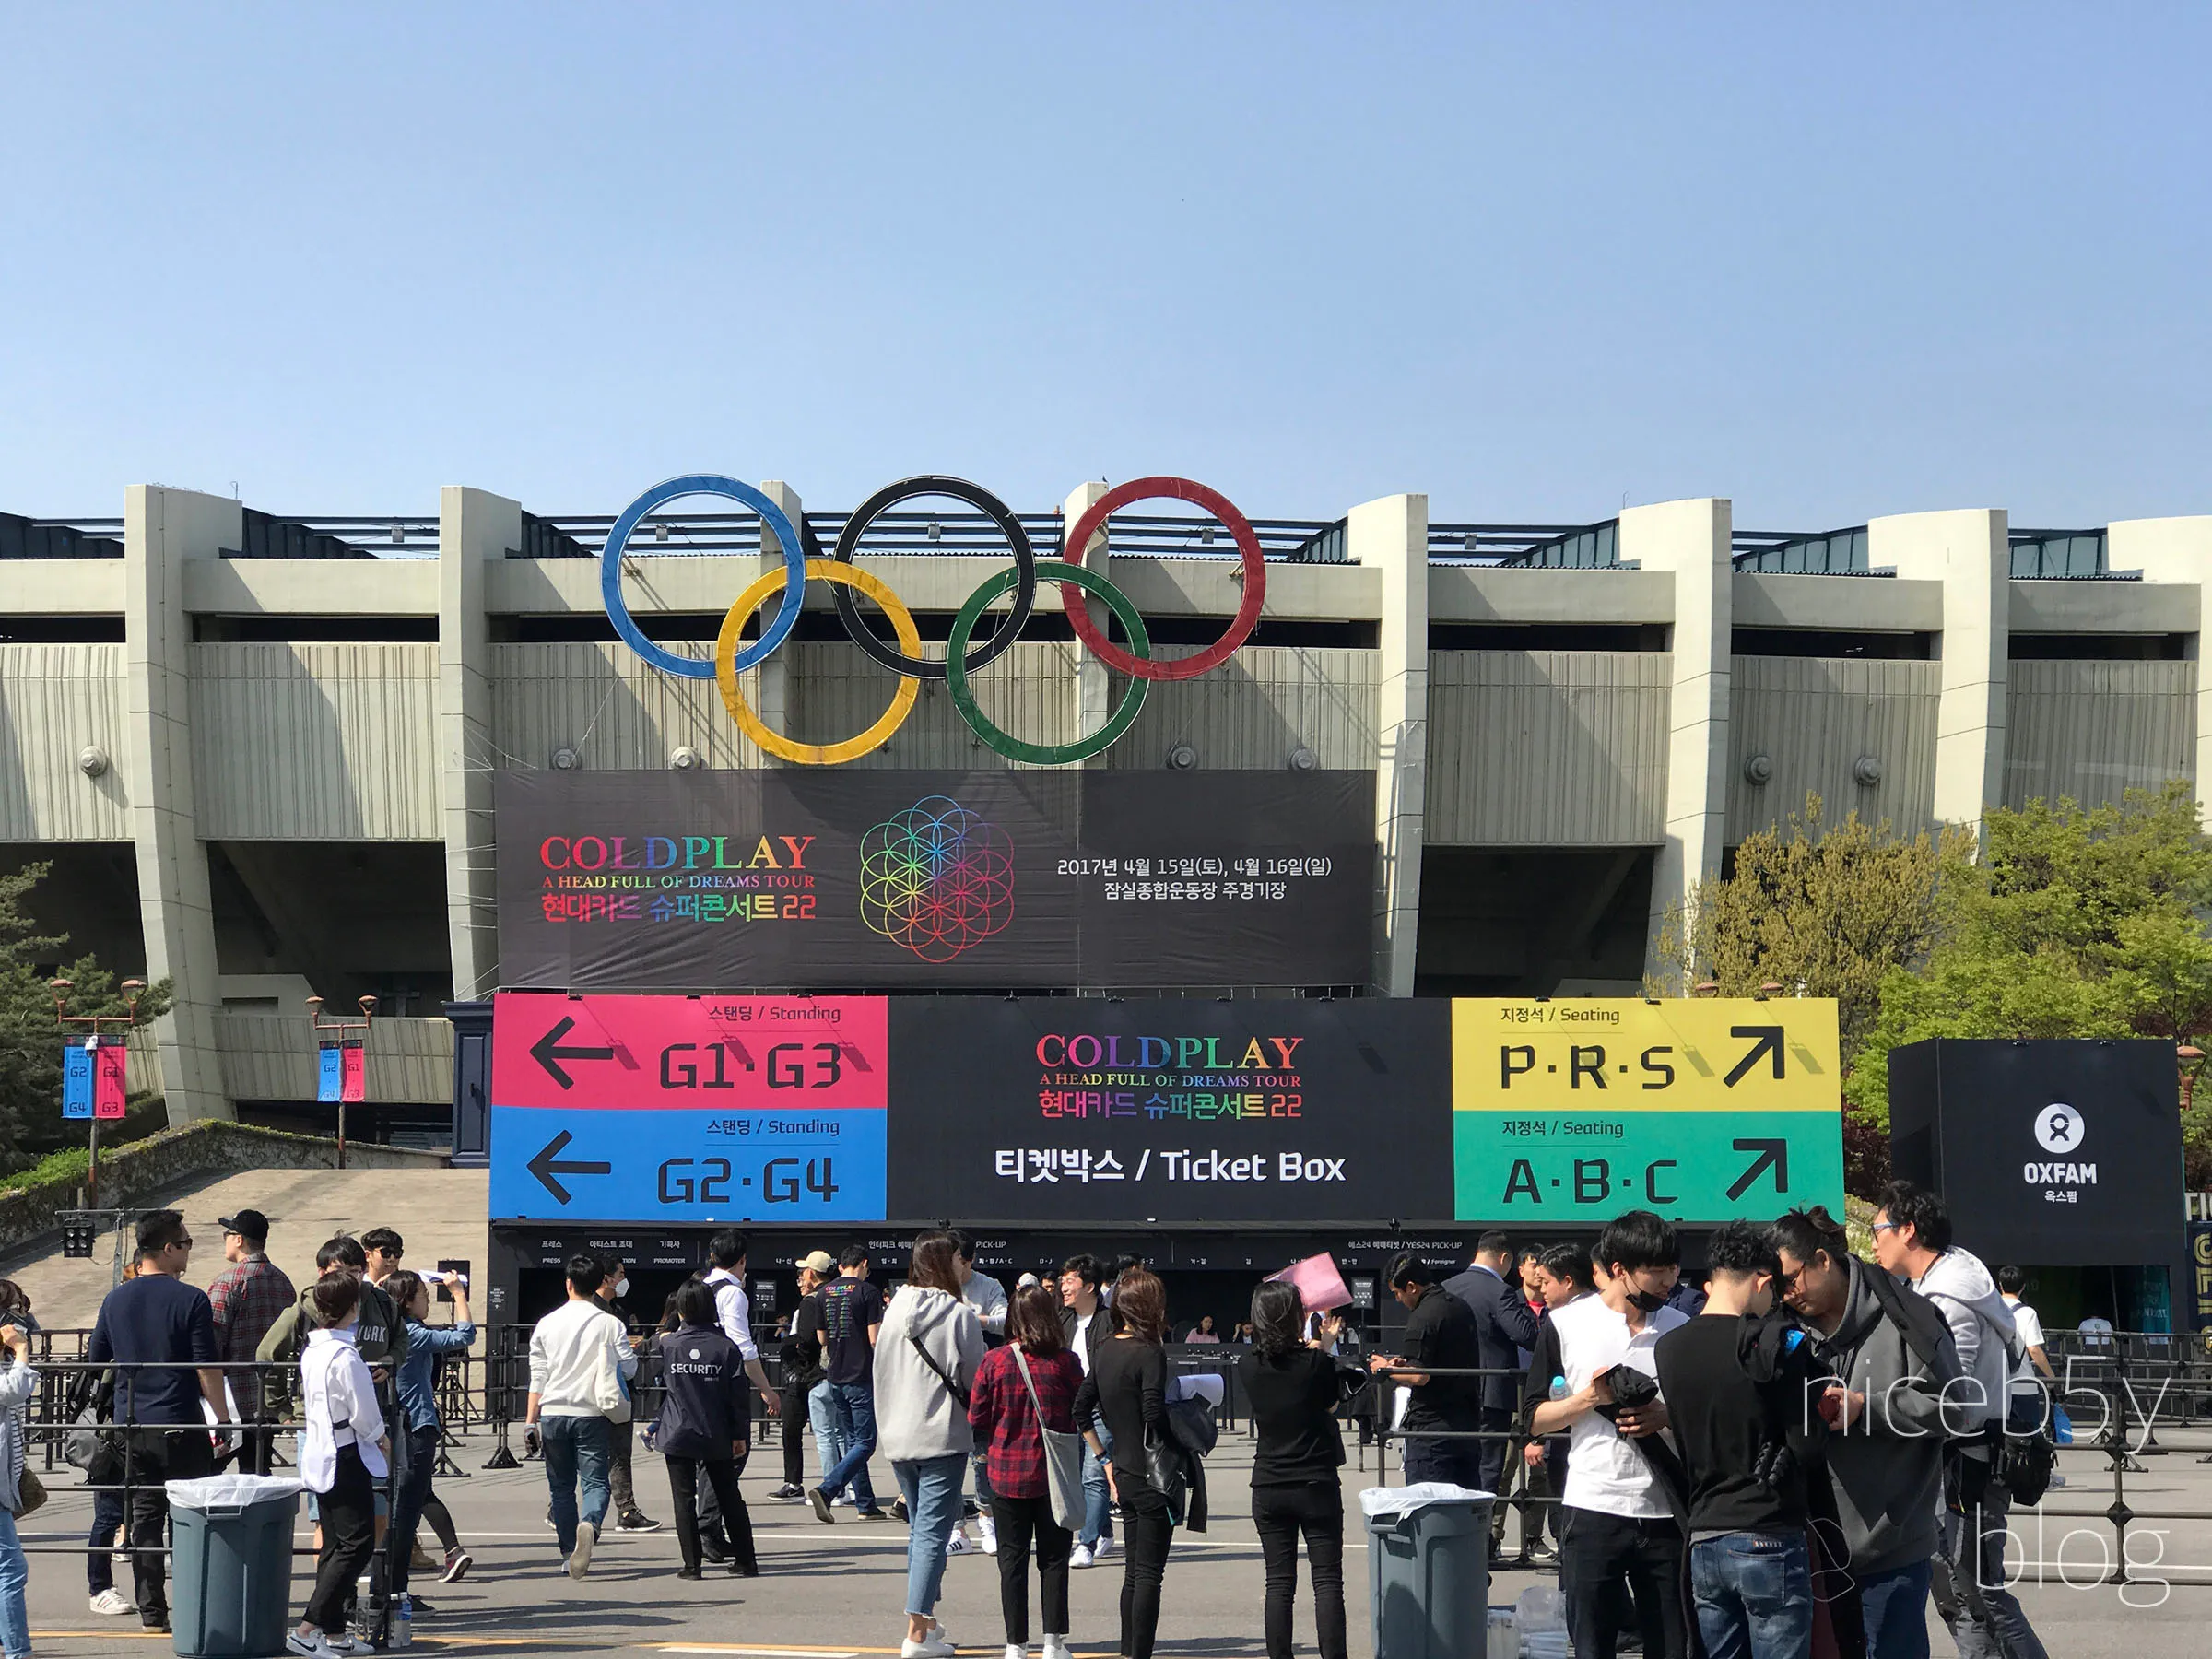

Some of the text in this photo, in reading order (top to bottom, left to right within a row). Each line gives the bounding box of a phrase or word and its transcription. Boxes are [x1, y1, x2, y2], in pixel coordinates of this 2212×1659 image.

[540, 836, 815, 869] COLDPLAY
[1058, 858, 1331, 876] 2017년 4월 15일(토), 4월 16일(일)
[543, 876, 814, 888] A HEAD FULL OF DREAMS TOUR
[1105, 882, 1286, 900] 잠실종합운동장 주경기장
[542, 893, 815, 922] 현대카드 슈퍼콘서트 22
[710, 1006, 840, 1023] 스탠딩 / Standing
[1501, 1008, 1619, 1025] 지정석 / Seating
[1037, 1035, 1303, 1068] COLDPLAY
[69, 1066, 88, 1077] G2
[103, 1067, 120, 1077] G1
[324, 1064, 337, 1073] G2
[1040, 1074, 1300, 1087] A HEAD FULL OF DREAMS TOUR
[68, 1101, 88, 1112] G4
[101, 1102, 119, 1112] G3
[1039, 1090, 1301, 1119] 현대카드 슈퍼콘서트 22
[707, 1119, 839, 1136] 스탠딩 / Standing
[1503, 1121, 1623, 1138] 지정석 / Seating
[996, 1149, 1346, 1182] 티켓박스 / Ticket Box
[2025, 1163, 2097, 1183] OXFAM
[2045, 1191, 2077, 1202] 옥스팜
[540, 1240, 563, 1249] 프레스
[1406, 1241, 1430, 1251] YES24
[541, 1256, 562, 1265] PRESS
[653, 1256, 687, 1265] PROMOTER
[670, 1364, 722, 1375] SECURITY
